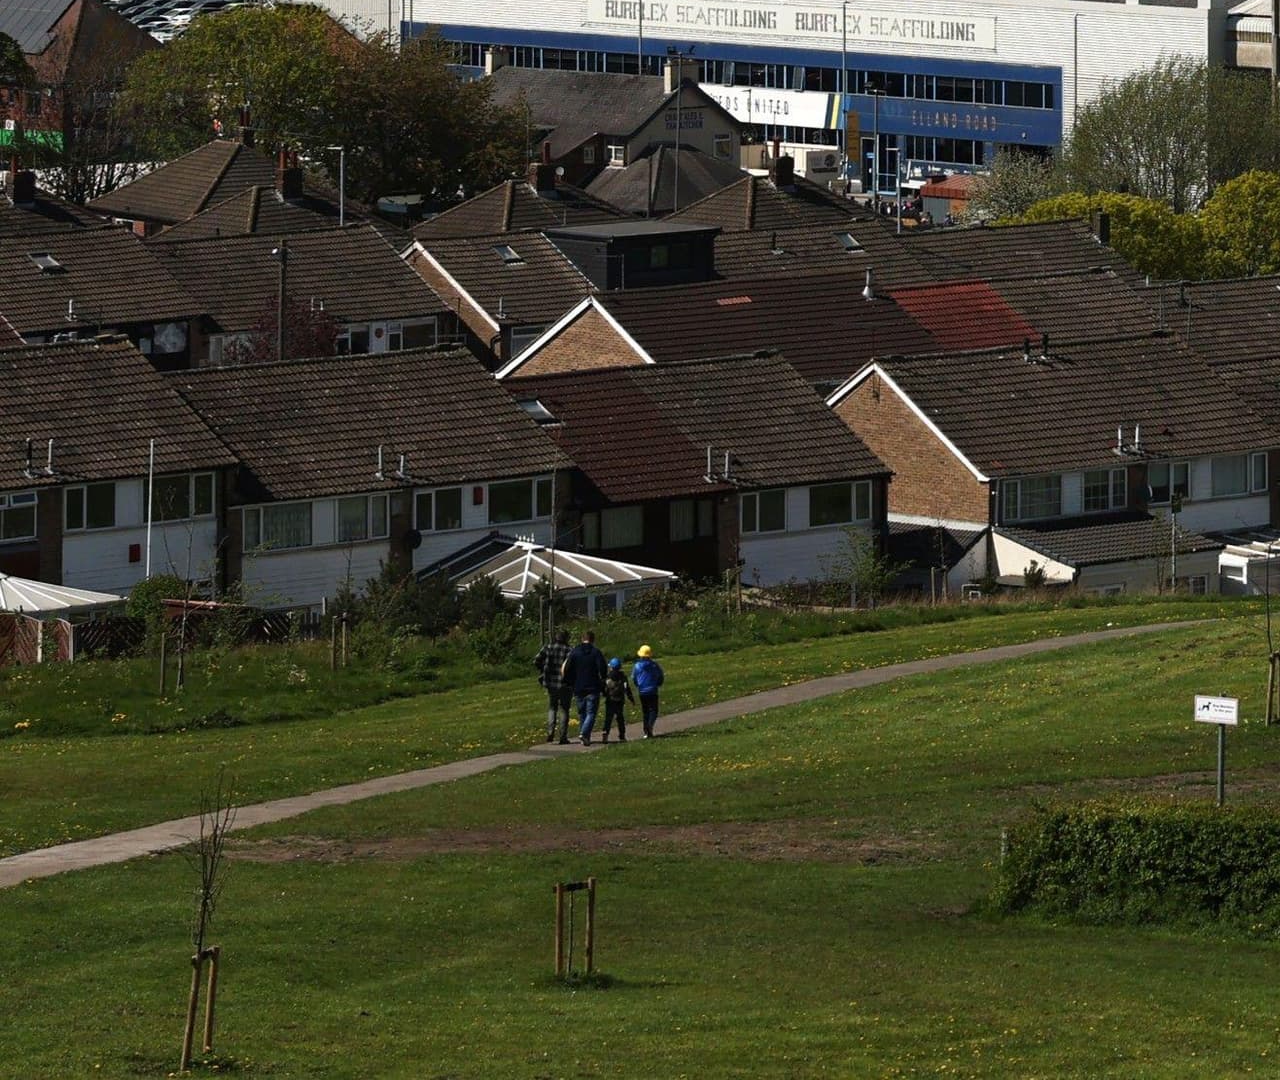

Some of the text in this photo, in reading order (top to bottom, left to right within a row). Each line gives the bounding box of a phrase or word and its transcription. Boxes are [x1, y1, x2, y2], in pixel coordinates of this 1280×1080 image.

[605, 0, 976, 42] BURFLEX SCAFFOLDING BURFLEX SCAFFOLDING
[747, 98, 789, 115] UNITED
[912, 109, 997, 132] ELLAND ROAD
